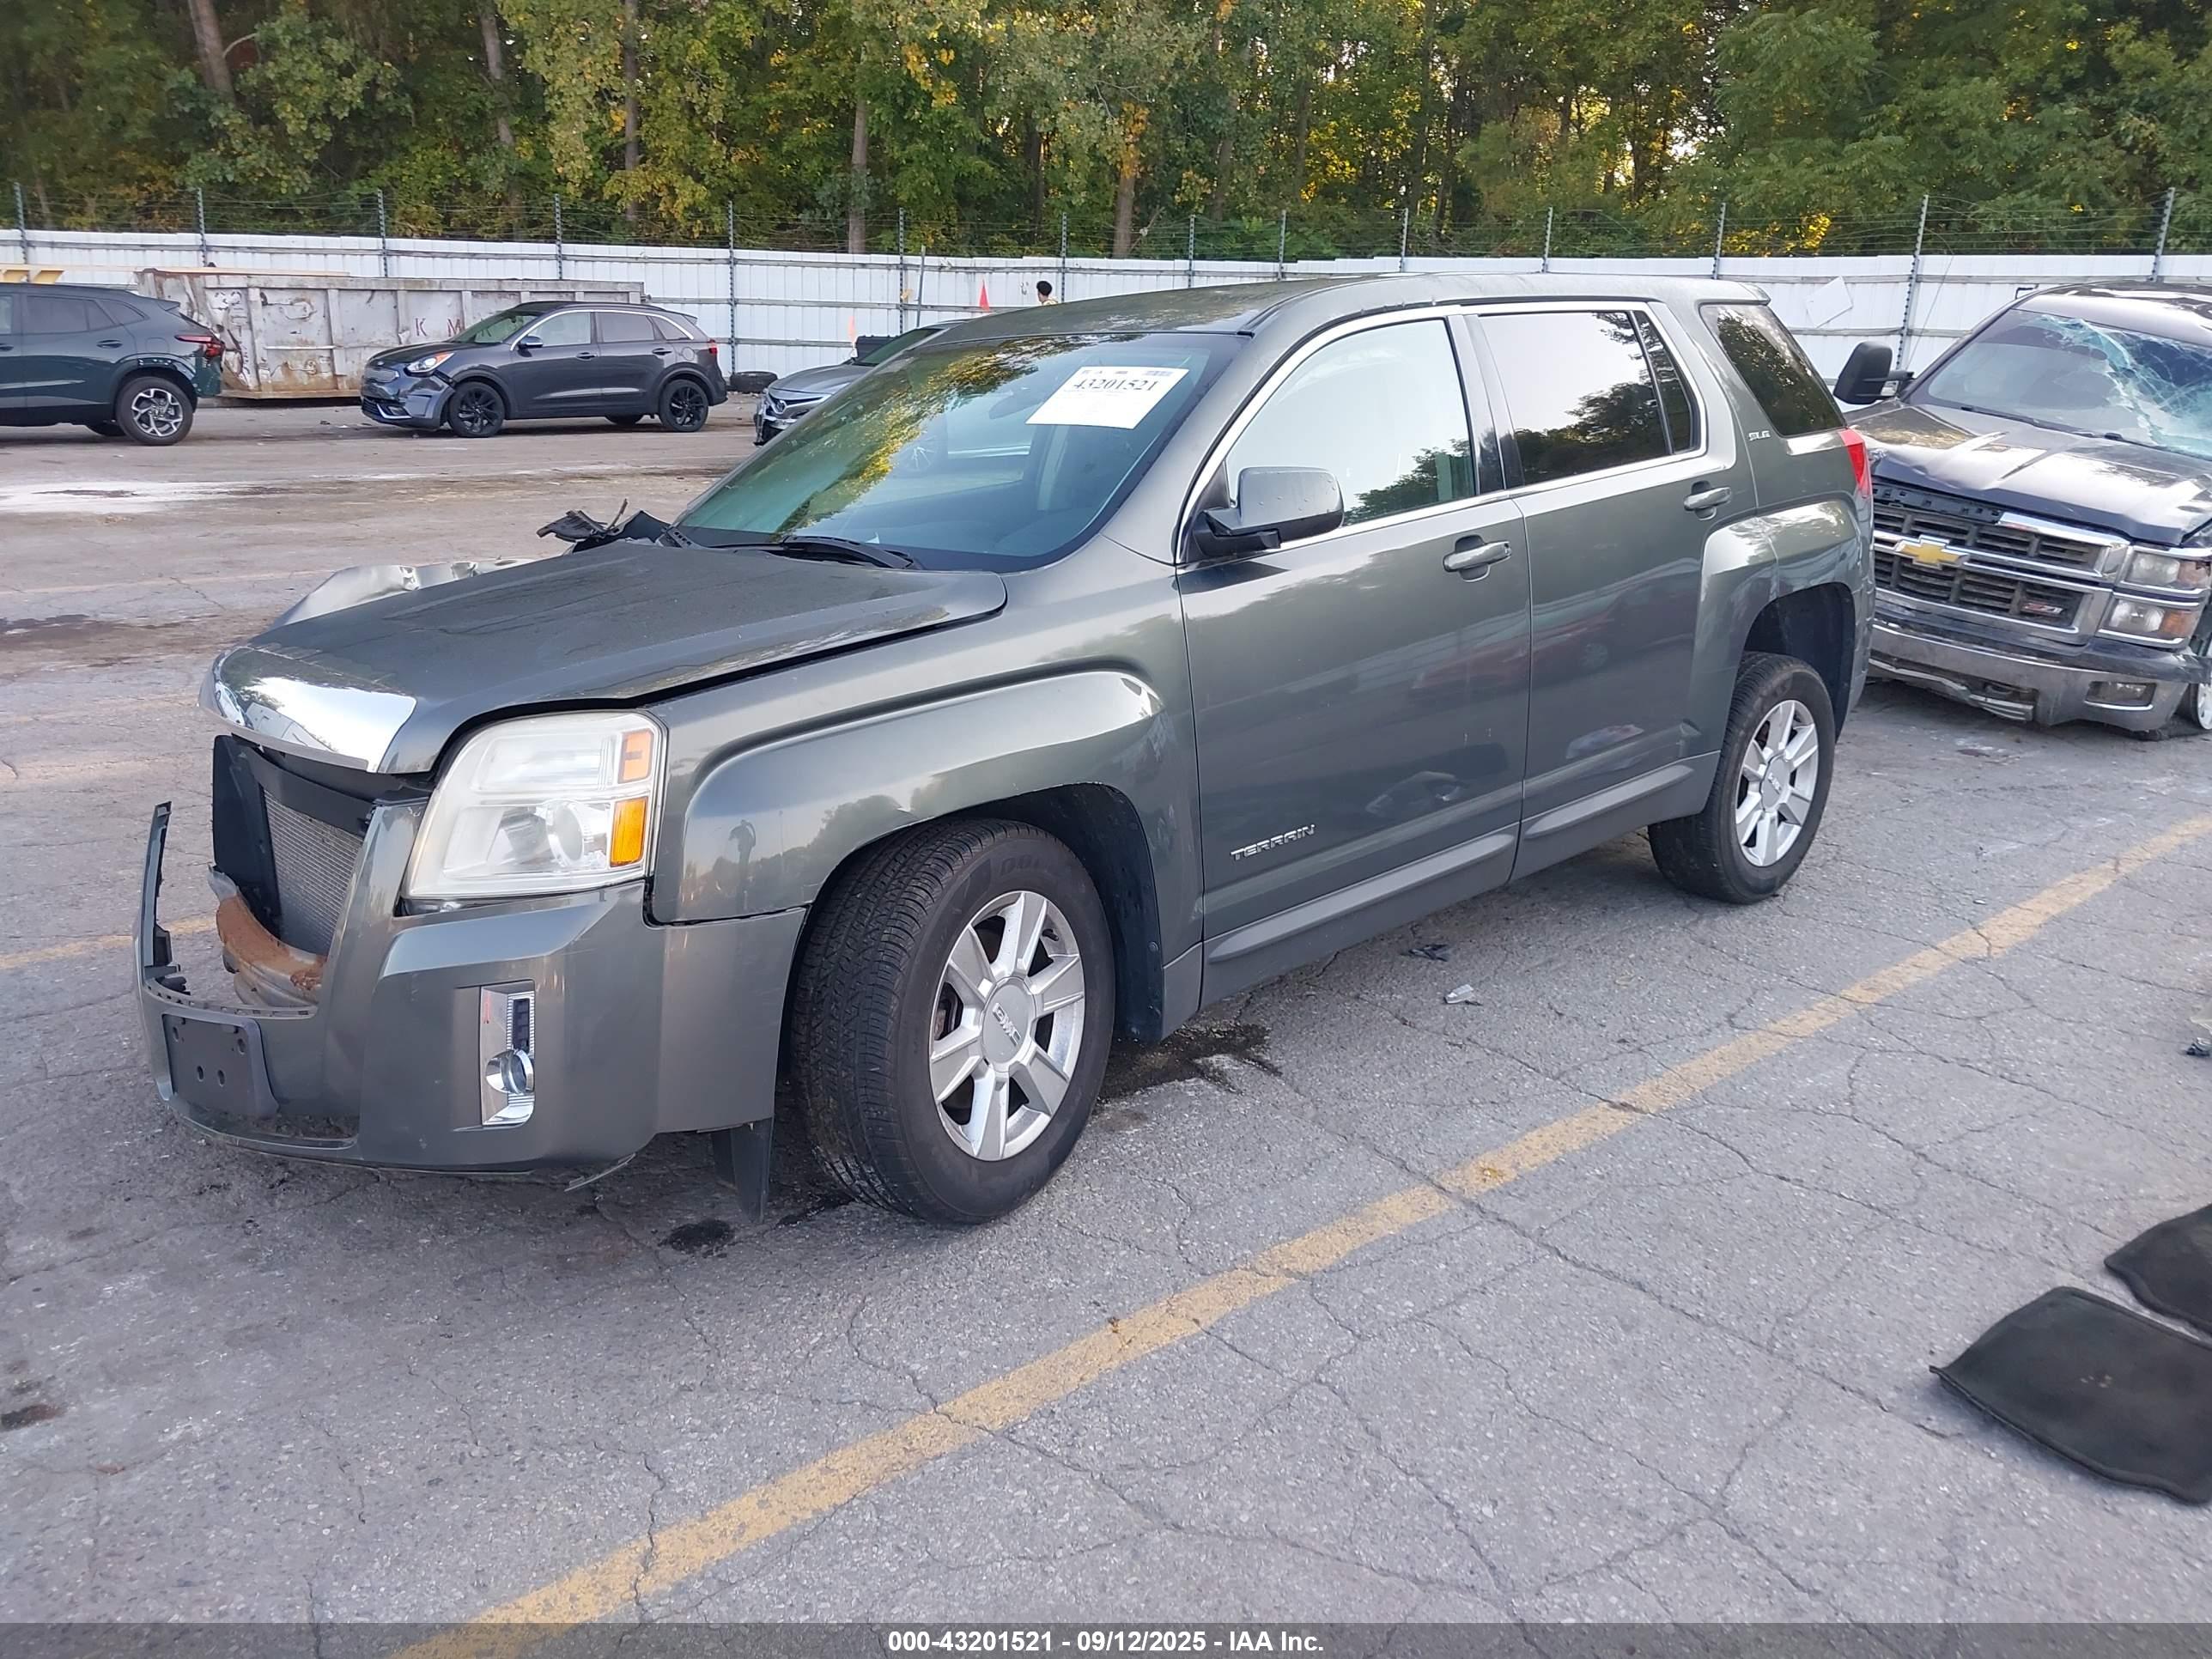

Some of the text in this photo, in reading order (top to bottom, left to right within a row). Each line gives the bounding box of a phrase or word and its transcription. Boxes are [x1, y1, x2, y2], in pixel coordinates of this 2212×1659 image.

[1073, 379, 1158, 392] 43201521
[1231, 824, 1315, 860] TERRAIN
[993, 1003, 1022, 1046] GMC
